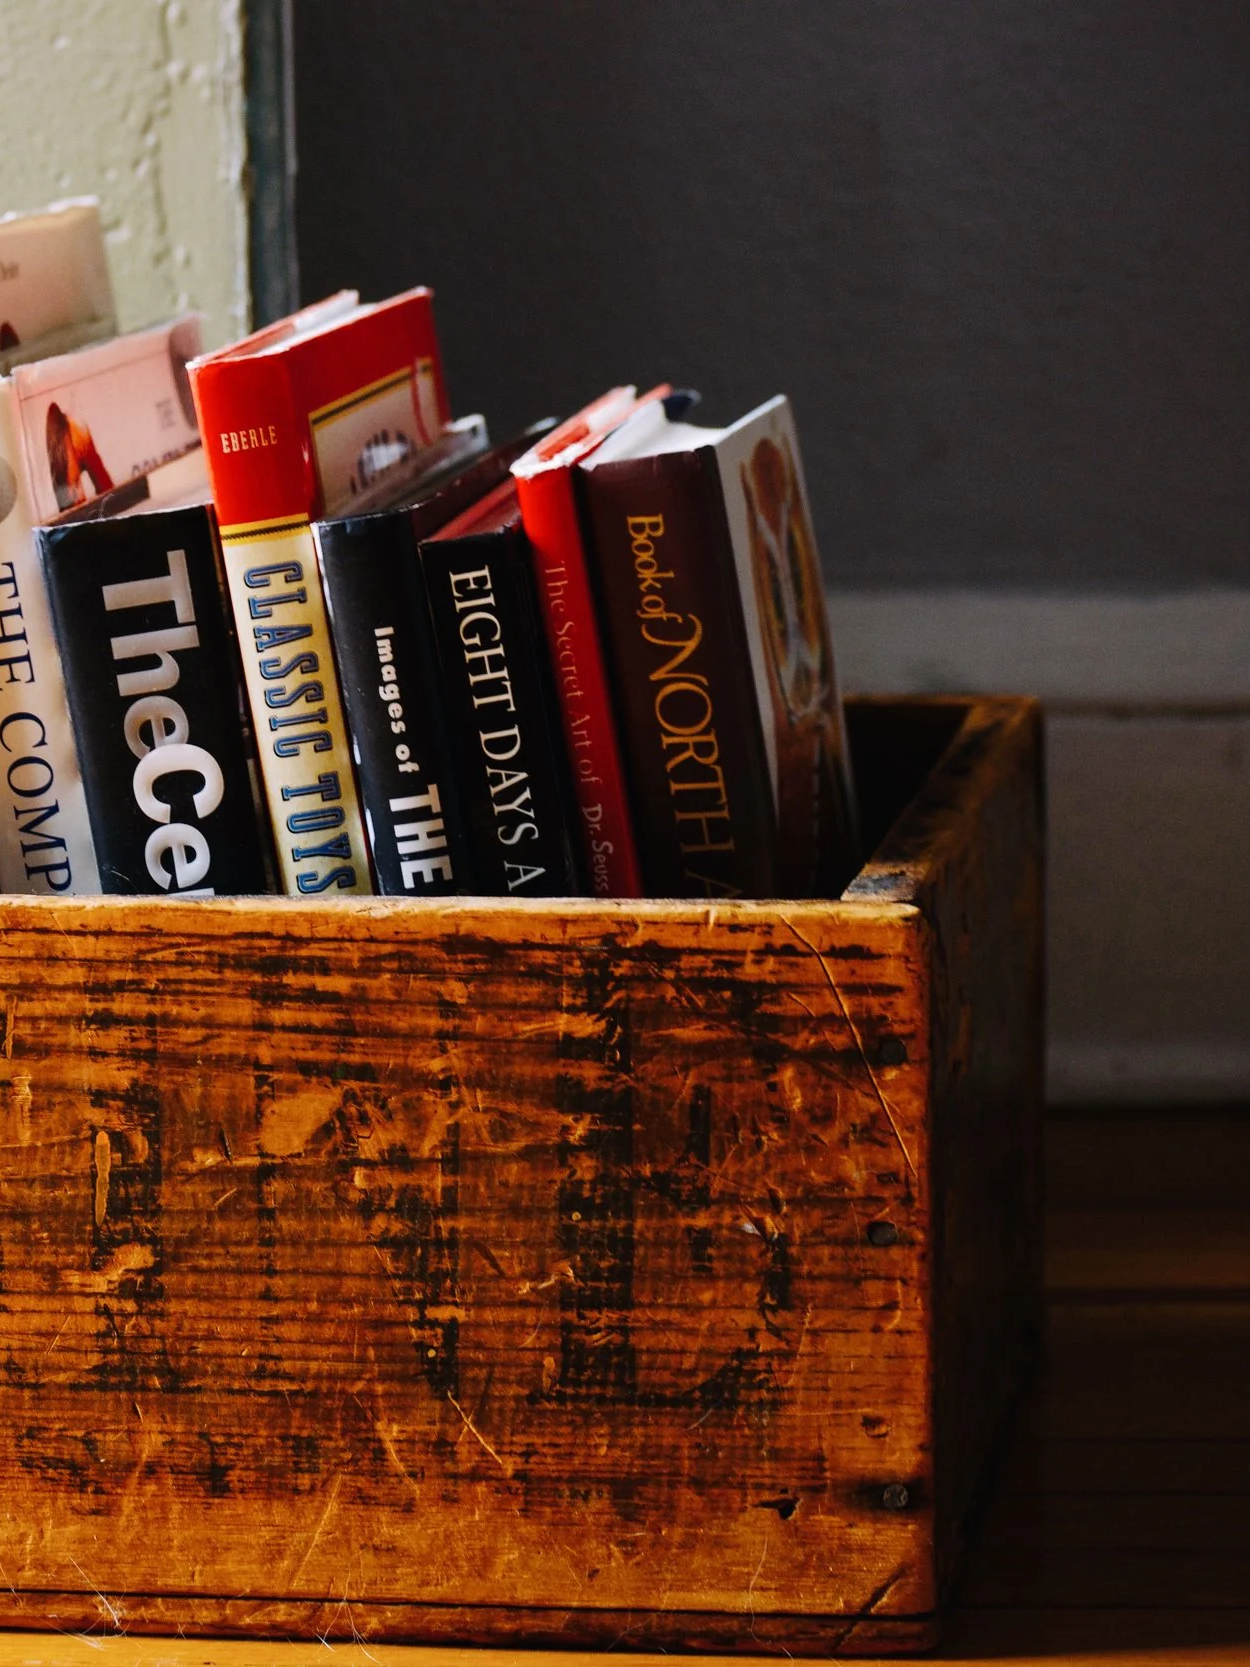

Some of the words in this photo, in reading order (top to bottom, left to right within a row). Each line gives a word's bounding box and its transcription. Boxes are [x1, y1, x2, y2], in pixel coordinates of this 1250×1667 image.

[220, 425, 278, 454] EBERLE
[626, 513, 675, 592] Book
[545, 560, 569, 612] The
[636, 595, 683, 624] of
[243, 560, 333, 758] CLASSIC
[449, 564, 516, 712] EIGHT
[556, 621, 585, 698] Secret
[374, 626, 406, 734] Images
[395, 743, 420, 773] of
[568, 710, 592, 747] Art
[641, 613, 736, 853] NORTH
[479, 724, 539, 845] DAYS
[578, 759, 603, 784] of
[281, 770, 357, 895] TOYS
[389, 784, 453, 889] THE
[582, 803, 603, 835] Dr.
[504, 860, 546, 892] A
[591, 841, 614, 891] Seuss
